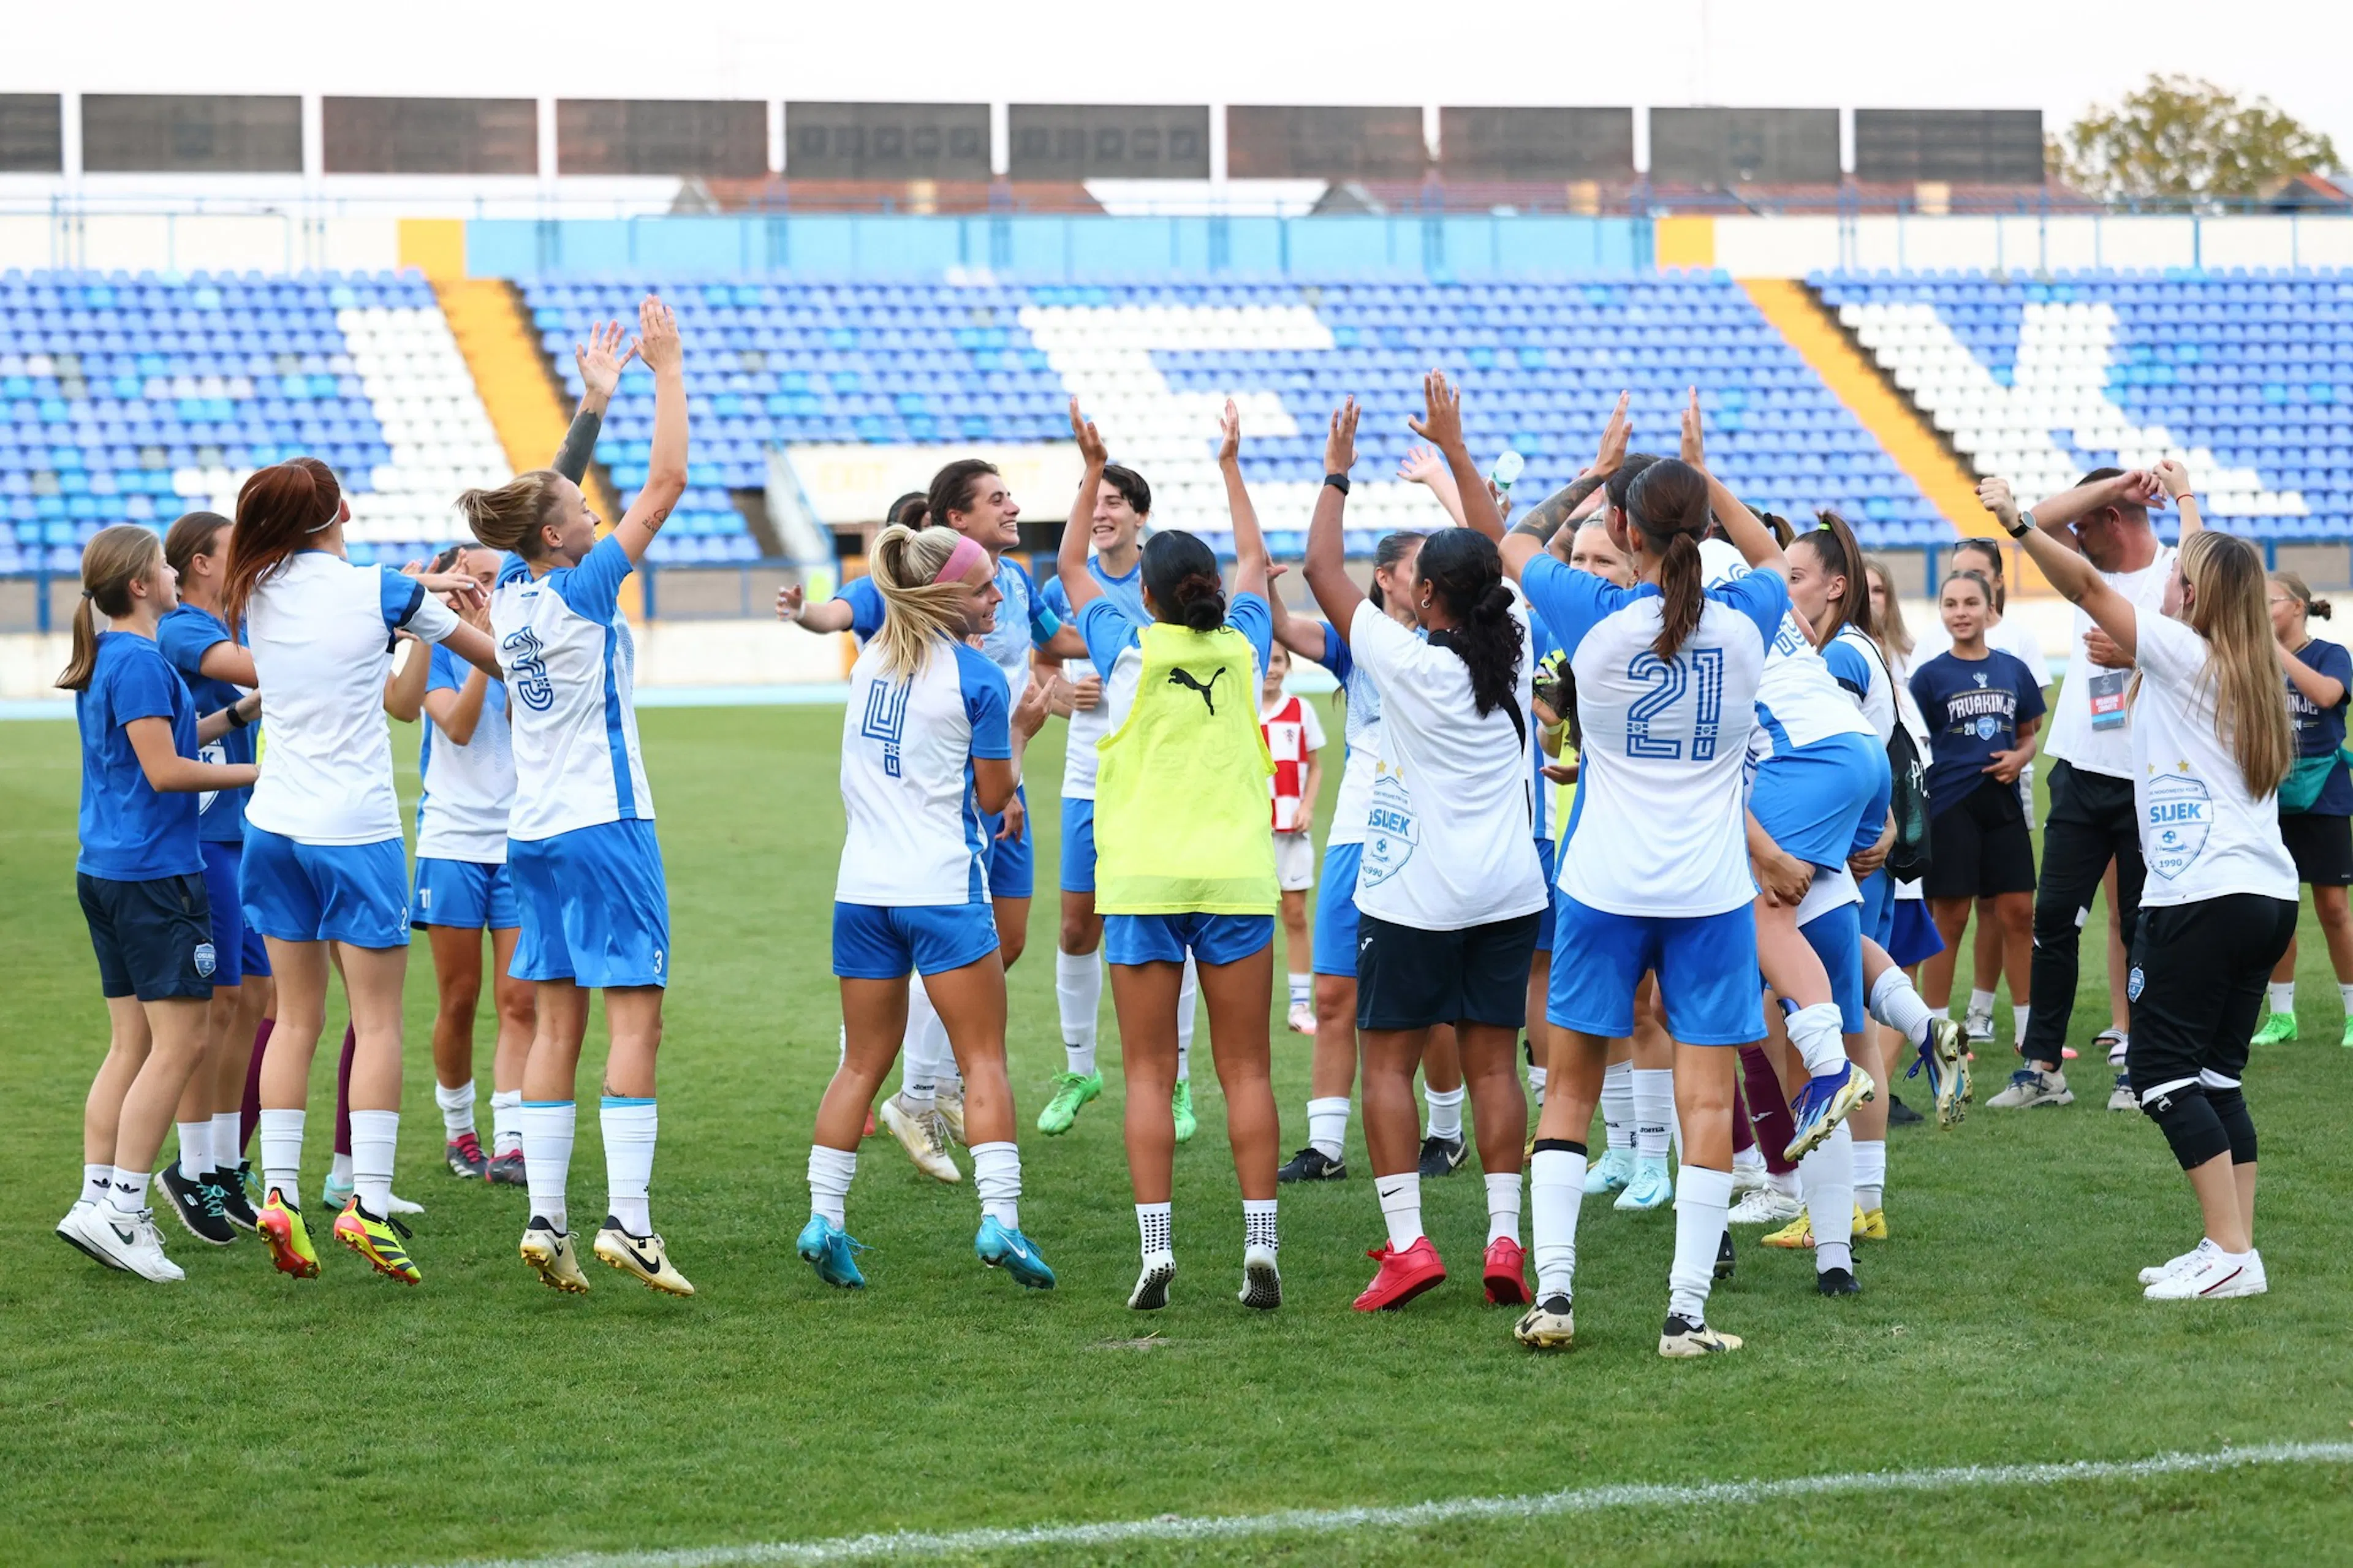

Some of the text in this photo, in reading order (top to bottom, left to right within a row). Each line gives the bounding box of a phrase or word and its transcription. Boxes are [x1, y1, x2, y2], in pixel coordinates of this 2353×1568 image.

[504, 626, 553, 711] 3
[1627, 648, 1722, 760] 21
[861, 673, 914, 779] 4
[2149, 803, 2202, 824] SIJEK
[2159, 858, 2183, 868] 1990
[419, 888, 431, 909] 11
[400, 906, 407, 930] 2
[654, 949, 663, 975] 3
